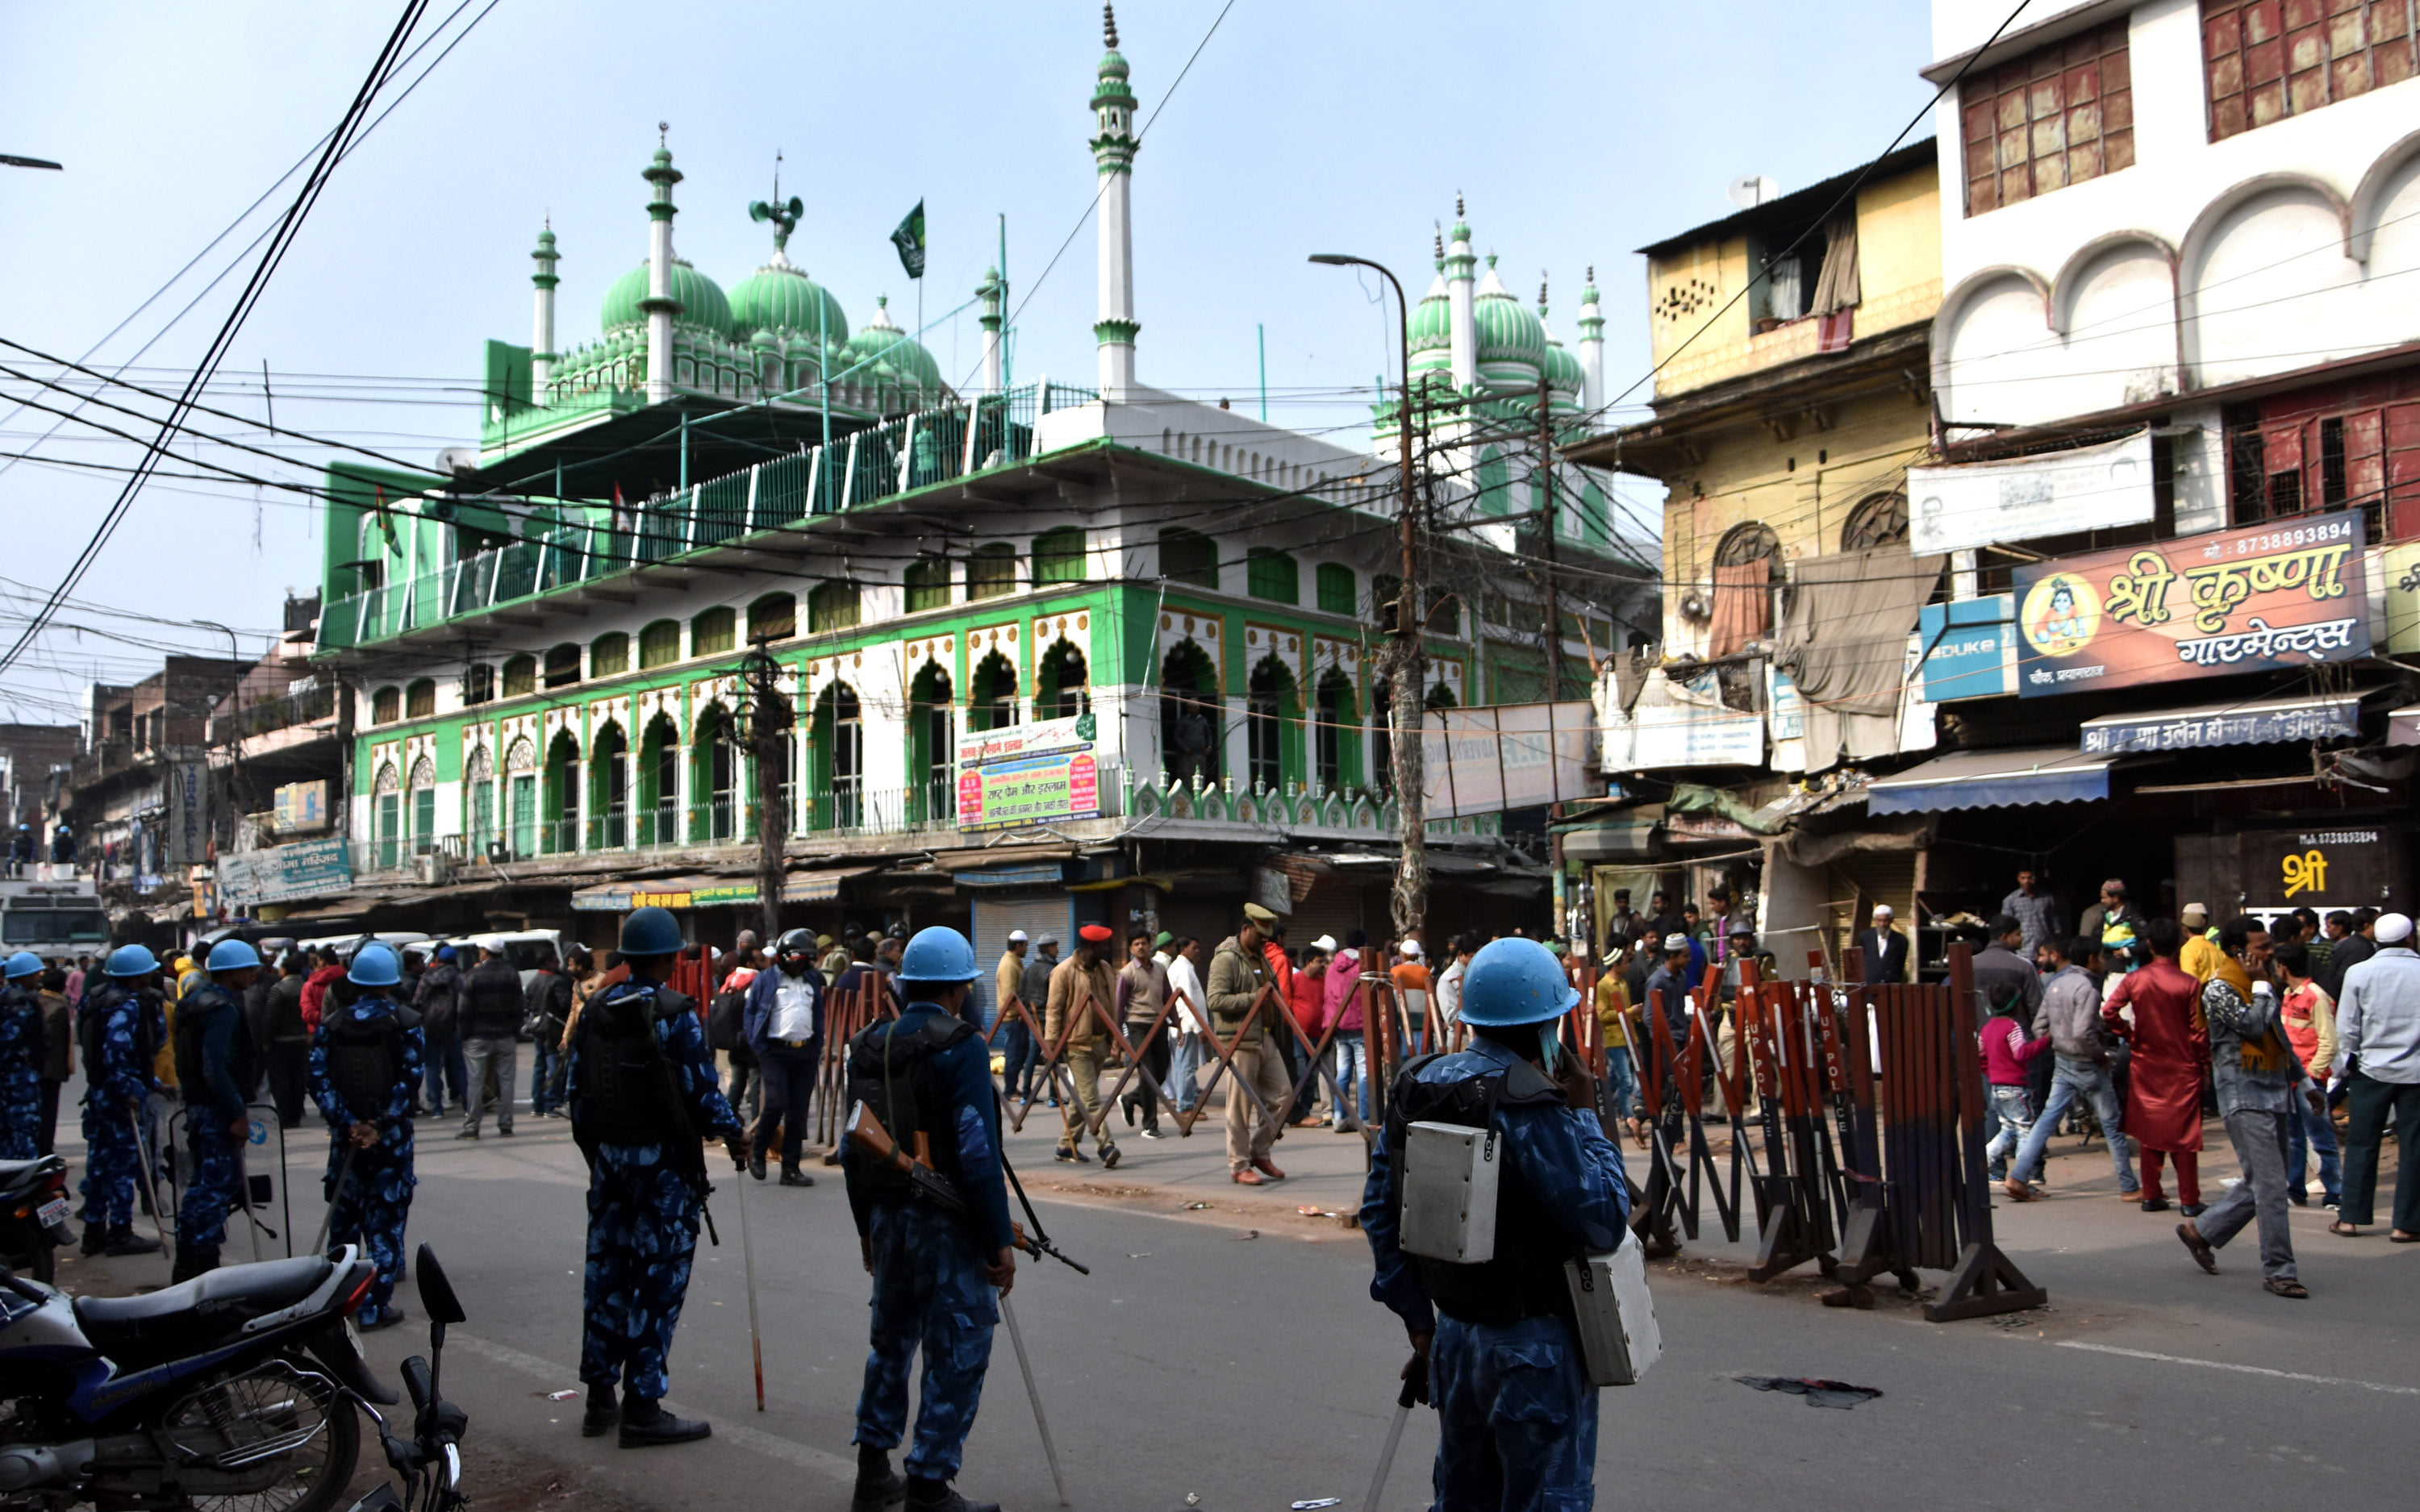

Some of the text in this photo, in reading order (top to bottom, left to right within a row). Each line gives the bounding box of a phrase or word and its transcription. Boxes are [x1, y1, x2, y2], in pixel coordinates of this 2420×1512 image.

[2236, 520, 2351, 555] 8738893894
[2105, 544, 2351, 633] श्री कृष्णा
[1022, 782, 1035, 795] और
[1037, 781, 1066, 794] इस्लाम
[2282, 850, 2328, 898] श्री
[1750, 1024, 1760, 1048] UP
[1821, 1017, 1847, 1132] UP POLICE
